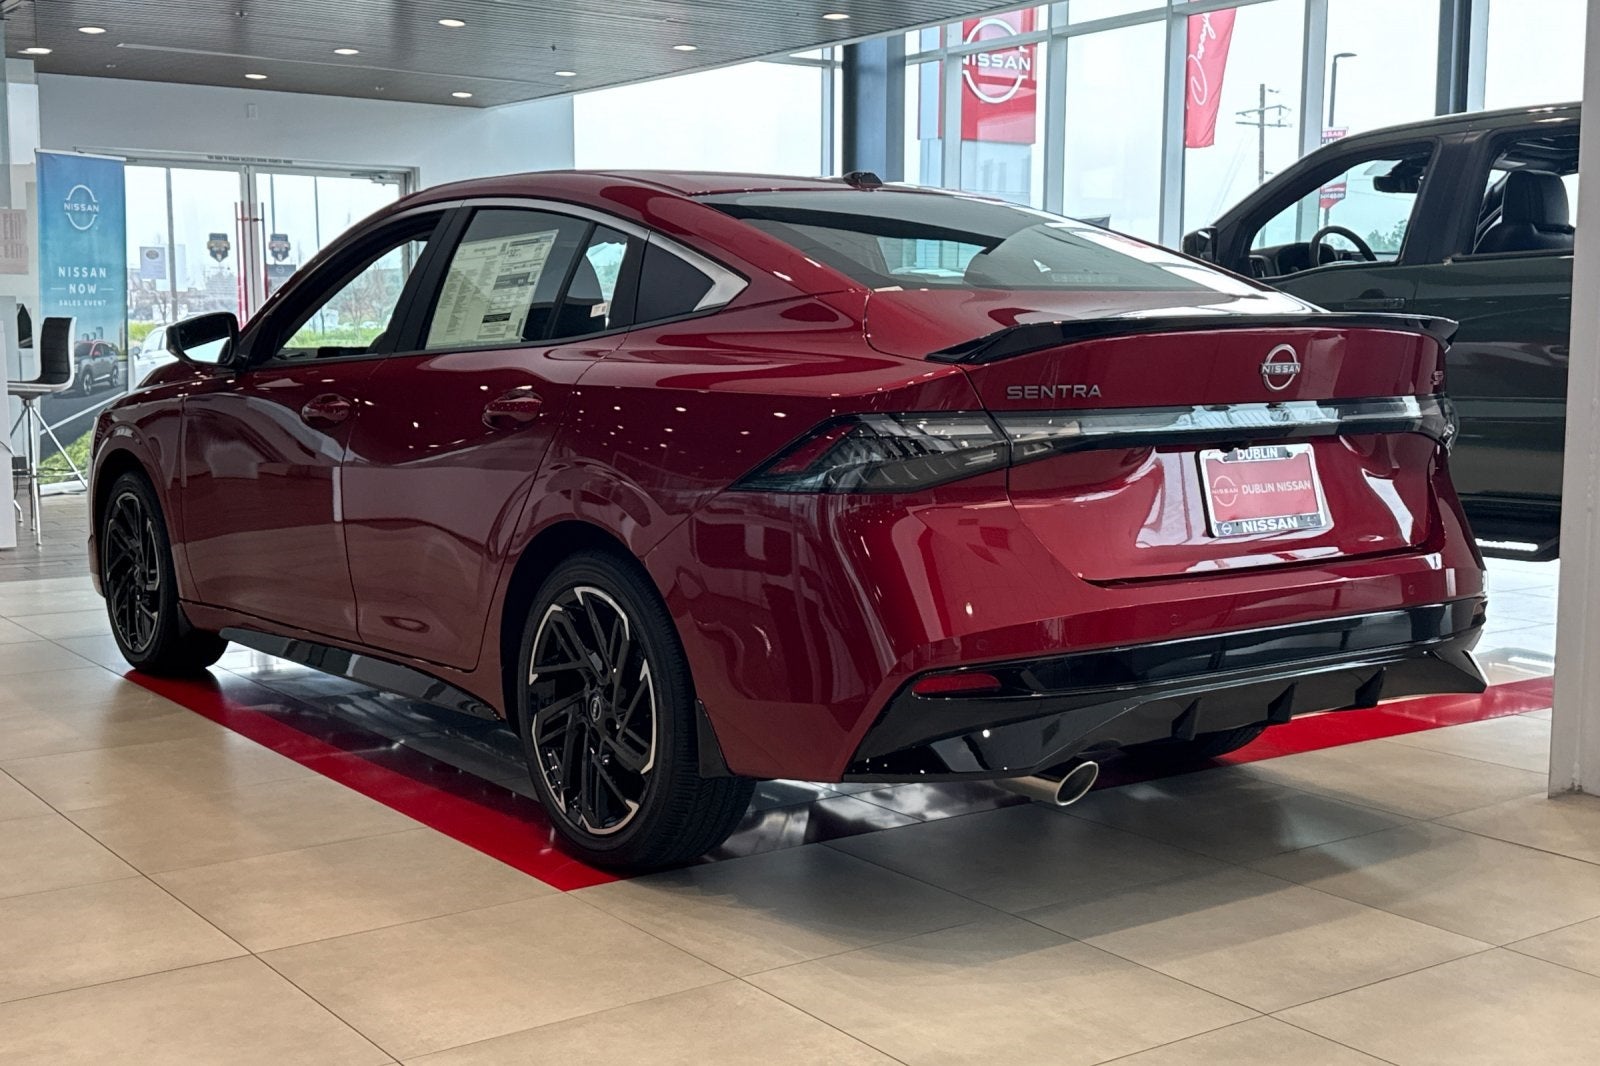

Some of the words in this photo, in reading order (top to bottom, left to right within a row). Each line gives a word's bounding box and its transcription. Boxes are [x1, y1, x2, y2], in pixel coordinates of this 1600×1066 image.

[64, 202, 99, 212] NISSAN
[58, 266, 106, 278] NISSAN
[69, 283, 97, 294] NOW
[1262, 364, 1300, 374] NISSAN
[1006, 384, 1102, 400] SENTRA
[1237, 447, 1278, 459] DUBLIN
[1241, 483, 1275, 494] DUBLIN
[1278, 480, 1311, 492] NISSAN
[1242, 517, 1298, 532] NISSAN
